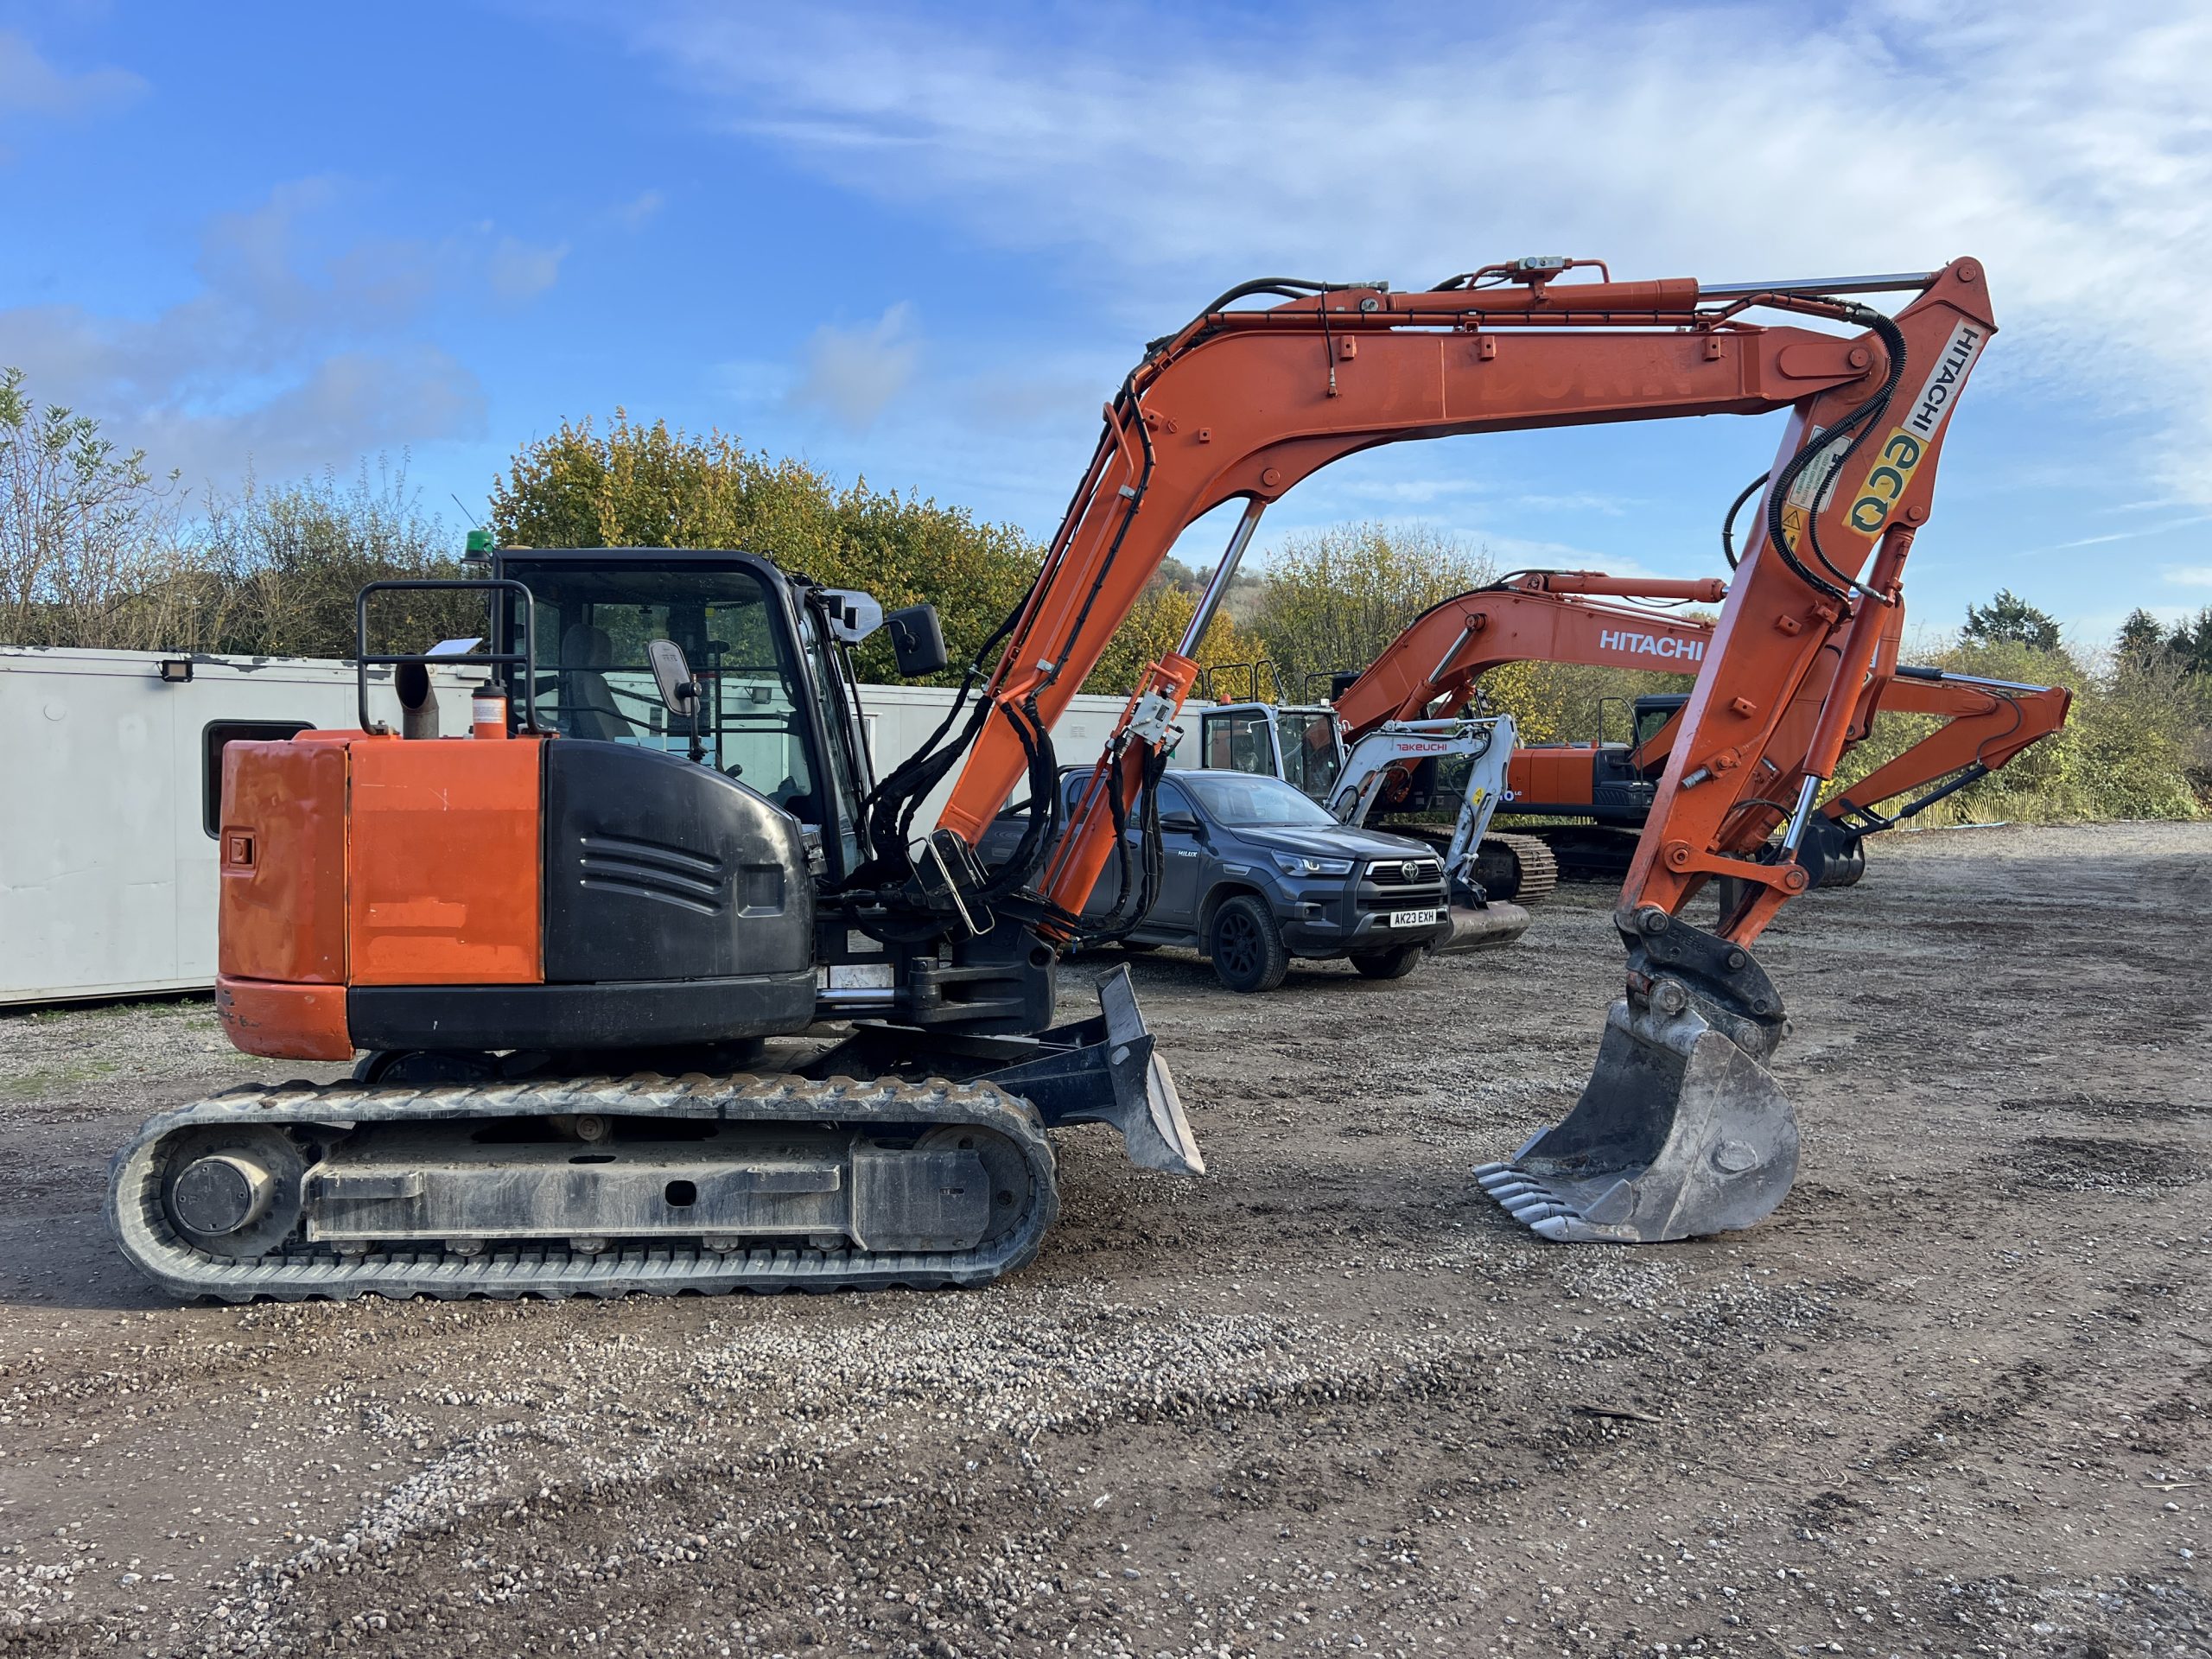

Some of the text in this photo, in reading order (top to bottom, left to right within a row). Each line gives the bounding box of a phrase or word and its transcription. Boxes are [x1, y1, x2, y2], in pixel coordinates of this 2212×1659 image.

[1912, 327, 1979, 432] HITACHI
[1599, 629, 1704, 661] HITACHI
[1395, 911, 1434, 925] AK23 EXH
